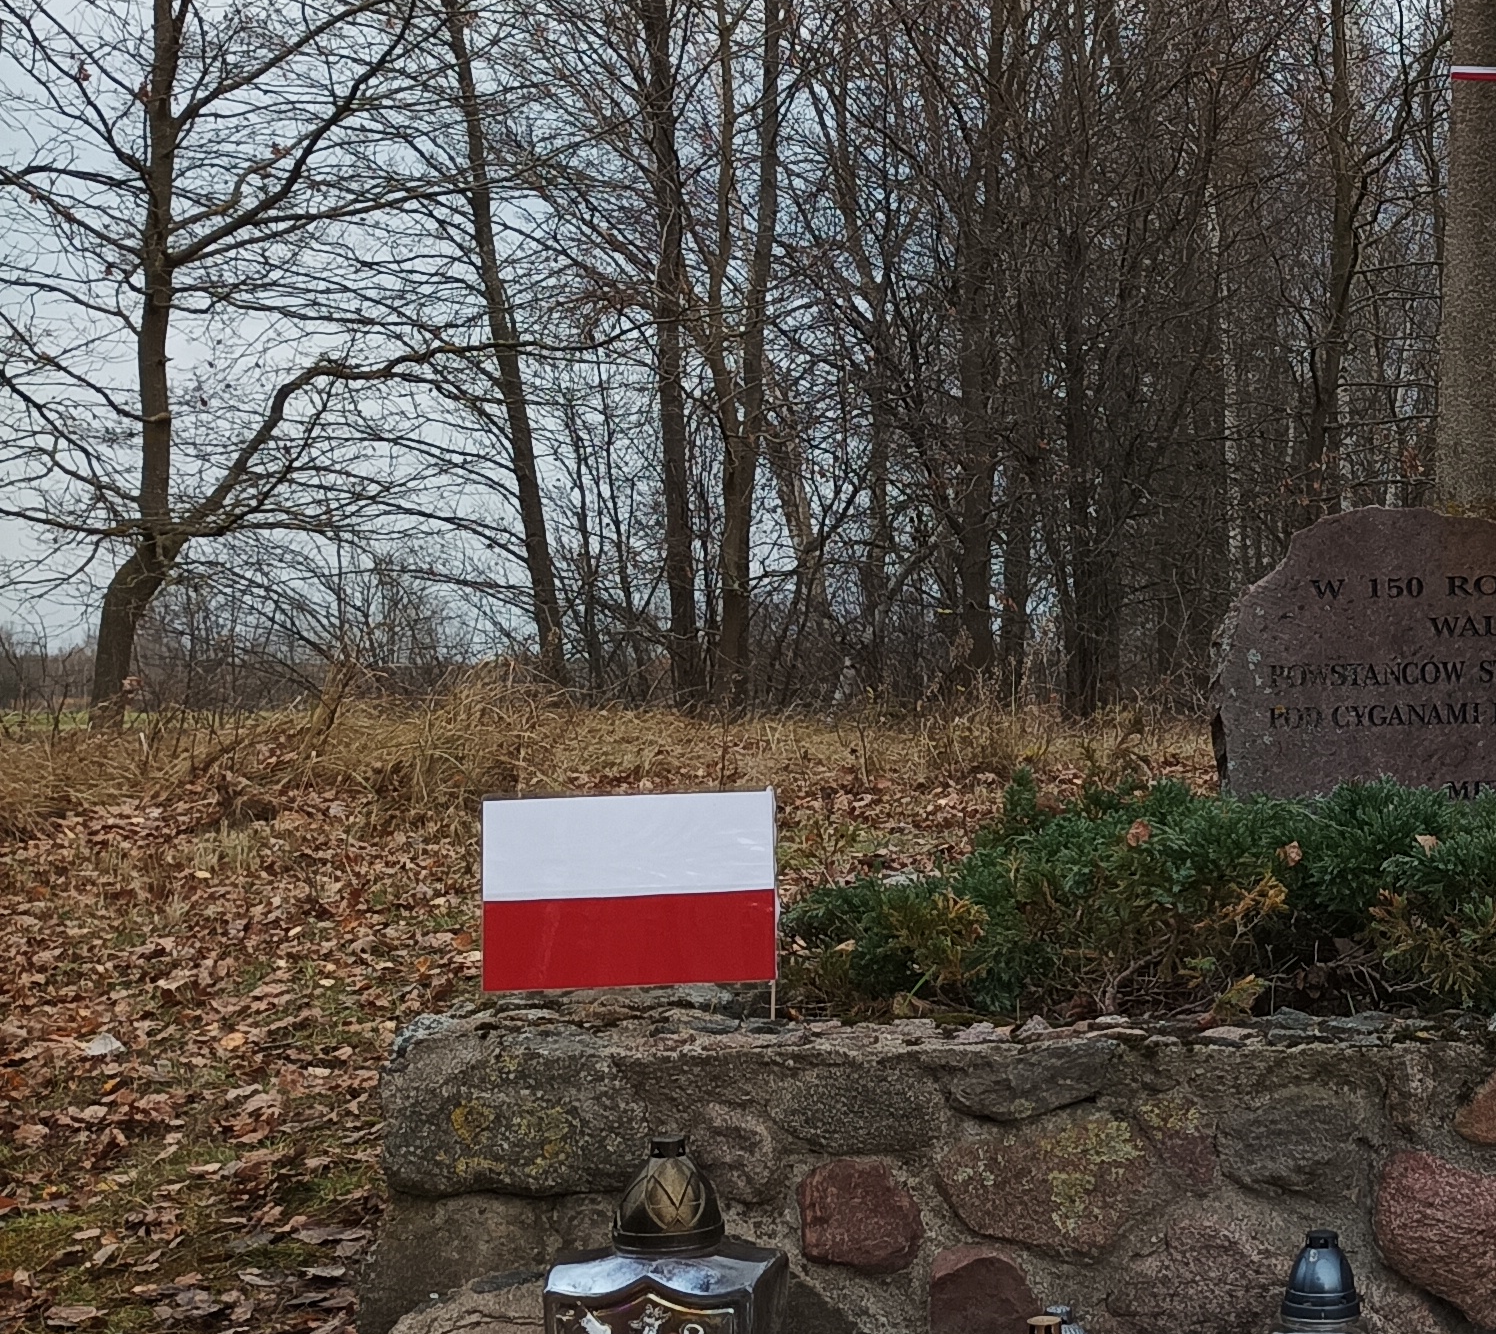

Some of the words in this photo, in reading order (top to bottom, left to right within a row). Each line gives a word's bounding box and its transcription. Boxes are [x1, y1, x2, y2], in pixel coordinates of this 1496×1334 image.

[1309, 579, 1345, 600] W
[1369, 576, 1424, 599] 150
[1270, 654, 1465, 688] POWSTAŃCÓW
[1269, 706, 1323, 729] POD
[1331, 702, 1481, 728] CYGANAMI
